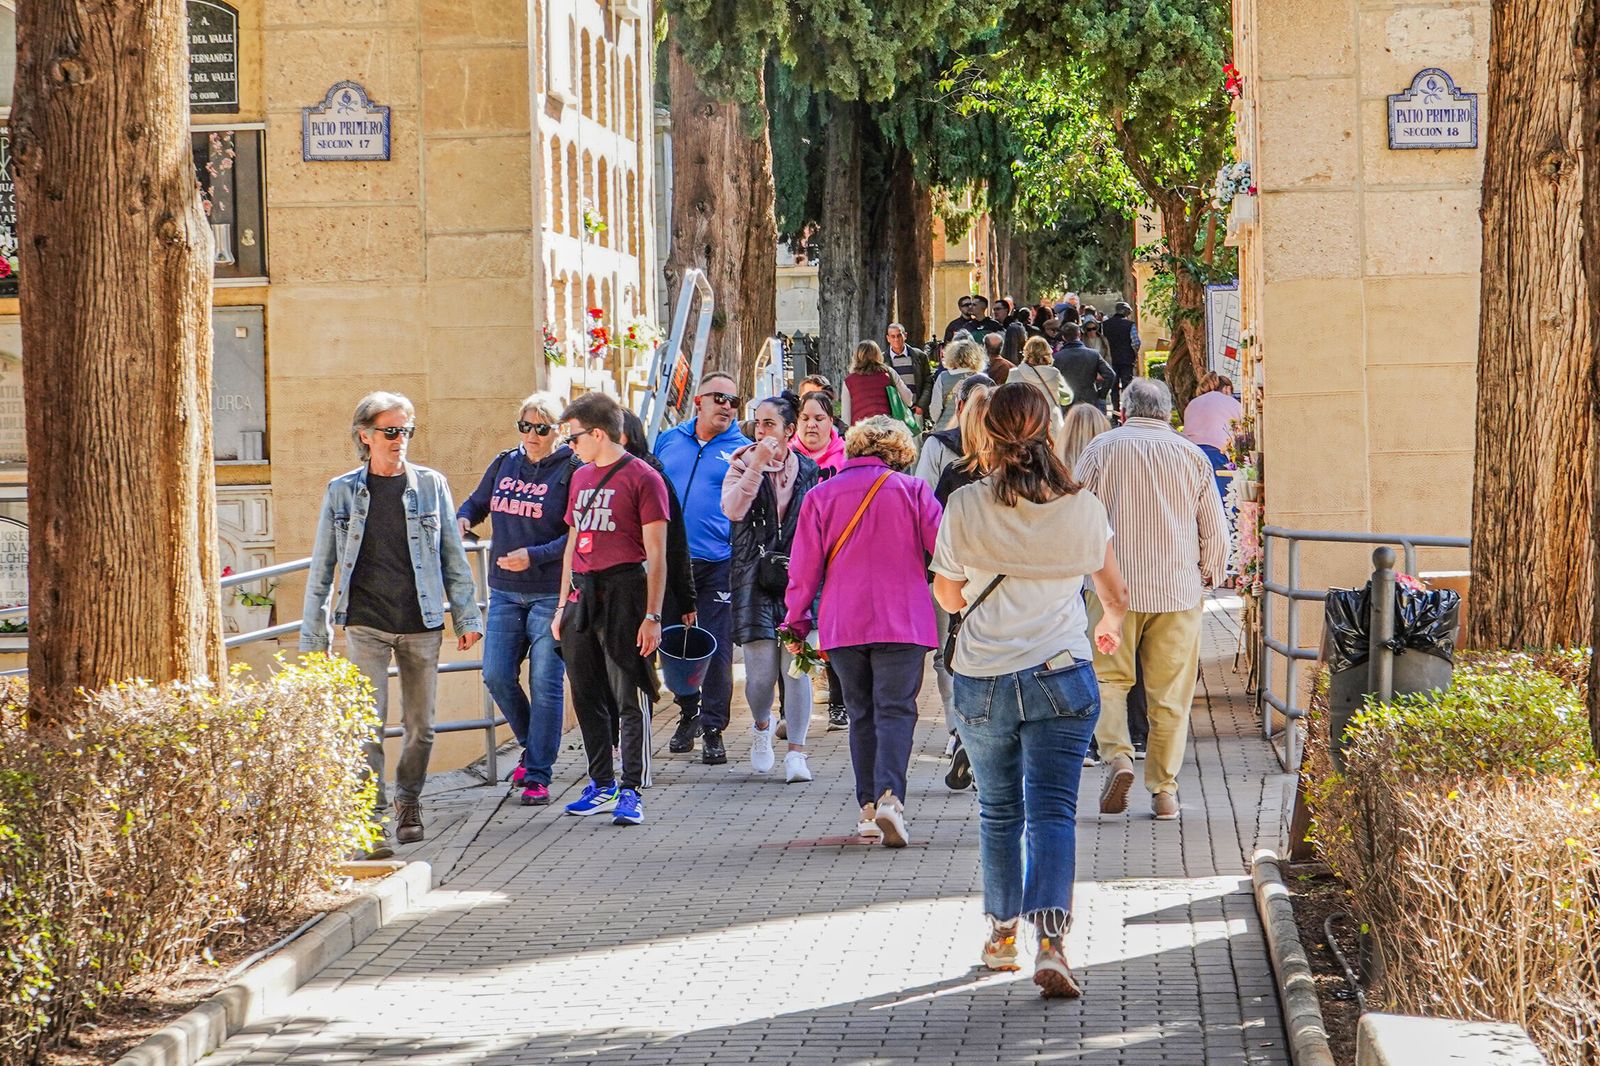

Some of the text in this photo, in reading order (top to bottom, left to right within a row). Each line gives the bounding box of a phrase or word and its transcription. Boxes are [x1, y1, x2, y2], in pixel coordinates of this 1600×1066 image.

[192, 34, 207, 44] DEL
[208, 33, 233, 44] VALLE
[190, 53, 233, 64] FERNANDEZ
[194, 72, 209, 83] DEL
[211, 71, 235, 82] VALLE
[1396, 108, 1470, 124] PATIO PRIMERO
[311, 121, 383, 136] PATIO PRIMERO
[1403, 127, 1460, 137] SECCION 18
[317, 139, 370, 149] SECCION 17
[498, 476, 549, 496] GOOD
[574, 488, 616, 510] JUST
[490, 495, 543, 519] HABITS
